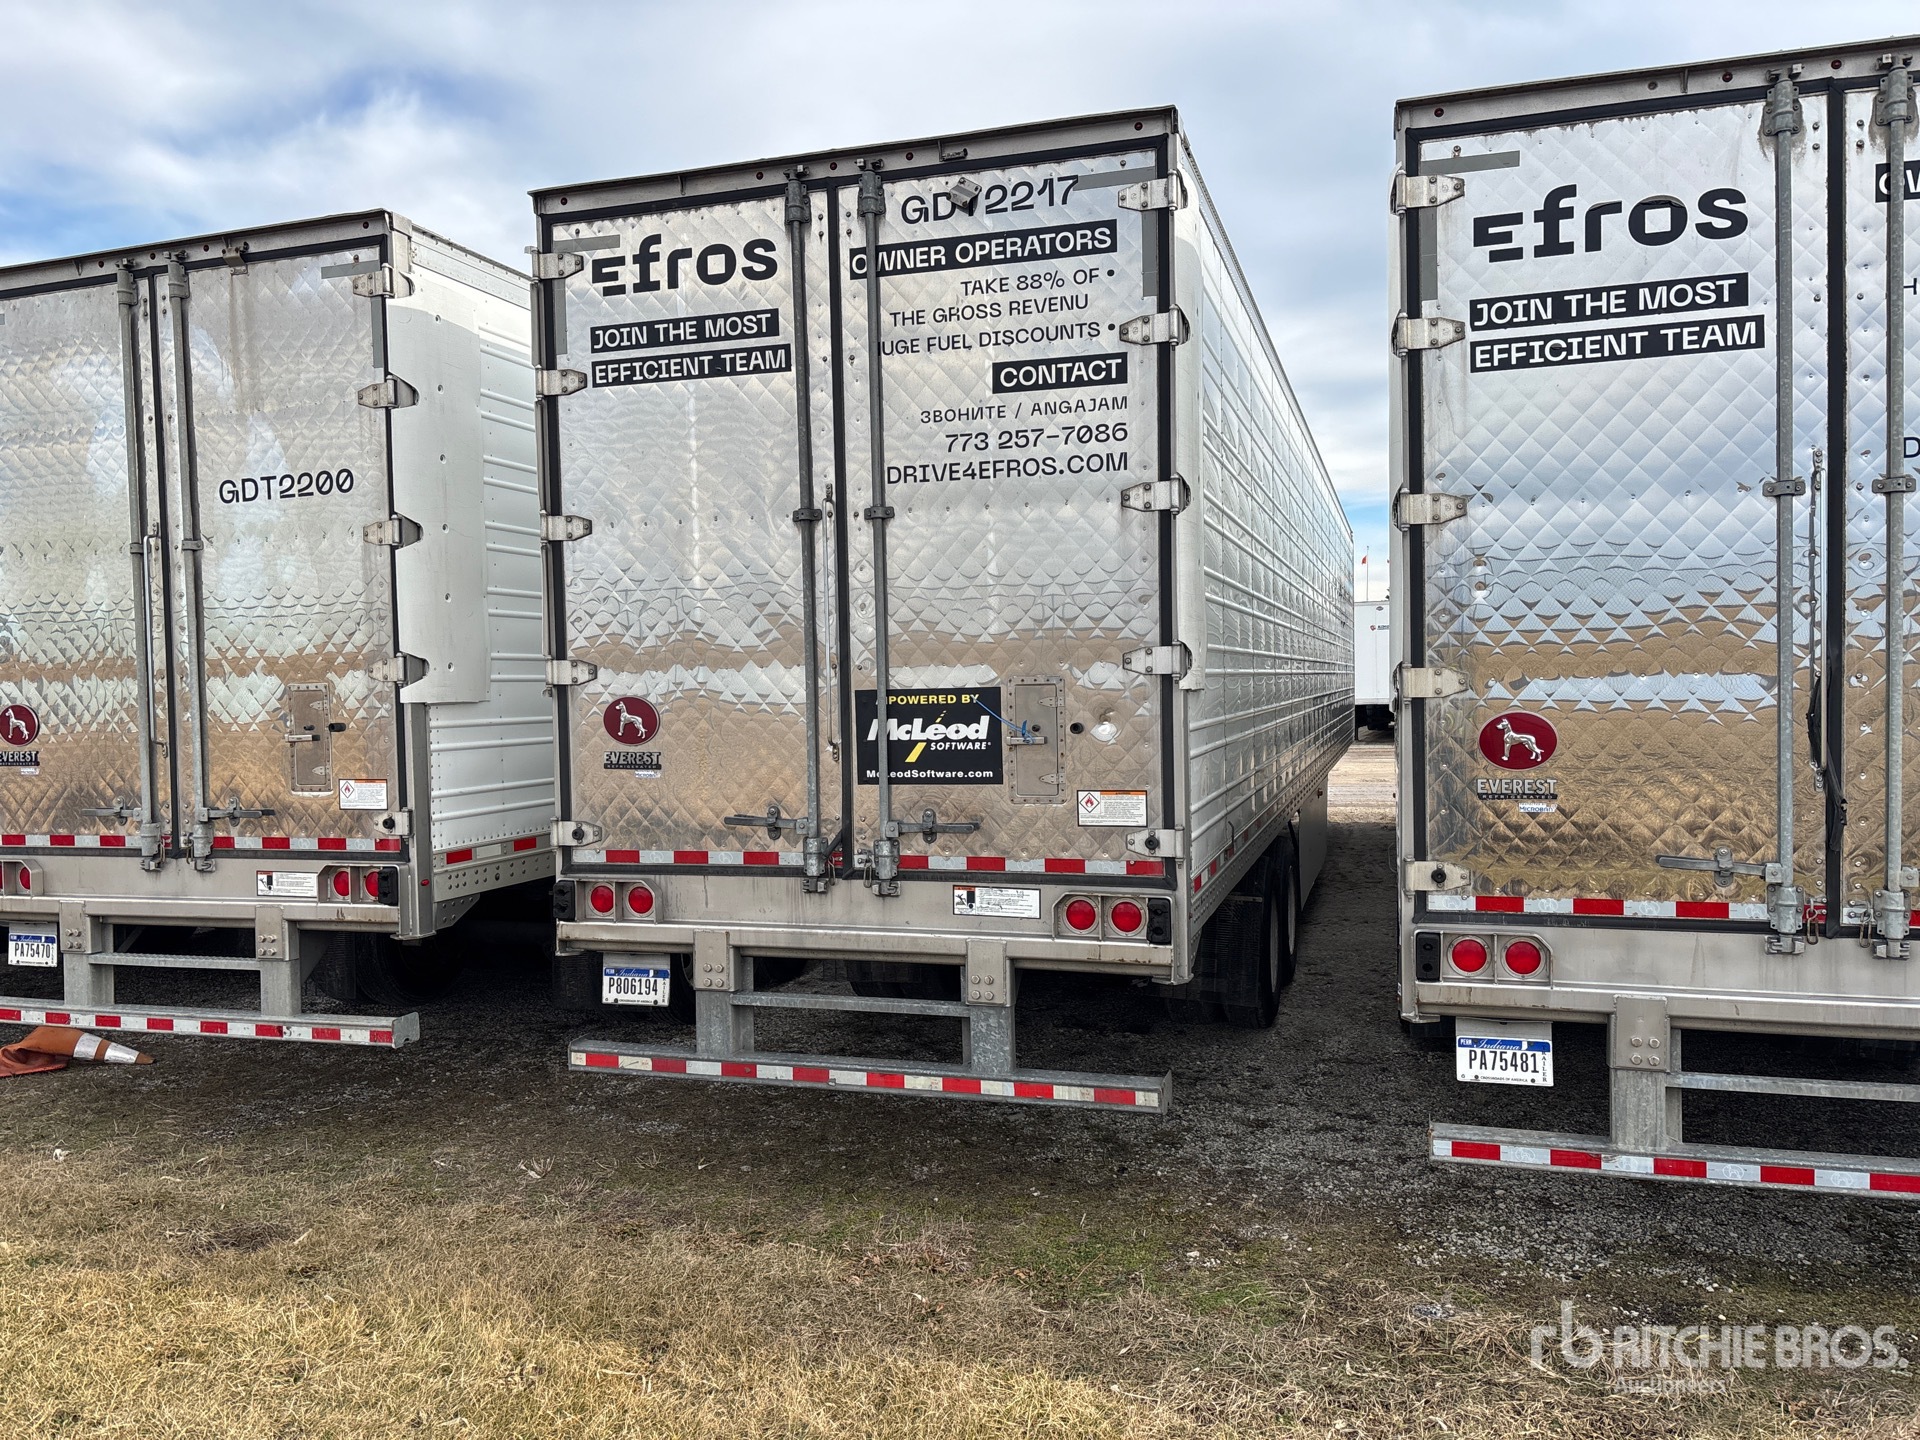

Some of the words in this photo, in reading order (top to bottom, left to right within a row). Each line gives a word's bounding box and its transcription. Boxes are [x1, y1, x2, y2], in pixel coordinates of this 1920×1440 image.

[1472, 183, 1749, 263] Efros
[591, 233, 778, 297] Efros
[851, 245, 946, 274] OWNER
[954, 227, 1112, 264] OPERATORS
[960, 276, 1010, 297] TAKE
[1016, 270, 1065, 291] 88%
[1072, 267, 1100, 286] OF
[889, 309, 926, 328] THE
[932, 301, 1003, 324] GROSS
[1473, 296, 1553, 327] JOIN
[1563, 289, 1627, 317] THE
[1638, 278, 1737, 310] MOST
[593, 325, 648, 349] JOIN
[654, 320, 698, 343] THE
[704, 313, 771, 338] MOST
[927, 333, 973, 353] FUEL
[978, 321, 1101, 348] DISCOUNTS
[1475, 330, 1649, 368] EFFICIENT
[1659, 321, 1758, 352] TEAM
[595, 355, 714, 384] EFFICIENT
[720, 349, 786, 373] TEAM
[1000, 358, 1123, 388] CONTACT
[1030, 395, 1128, 417] ANGAJAM
[945, 432, 990, 453] 773
[997, 422, 1129, 451] 257-7086
[886, 451, 1129, 485] DRIVE4EFROS.COM
[218, 468, 355, 504] GDT2200
[889, 694, 957, 705] POWERED
[961, 693, 980, 704] BY
[604, 752, 660, 764] EVEREST
[866, 769, 993, 779] MeodSoftware.com
[1477, 779, 1557, 794] EVEREST
[608, 976, 658, 996] P806194
[1477, 1038, 1521, 1051] Indiana
[1468, 1049, 1540, 1074] PA75481
